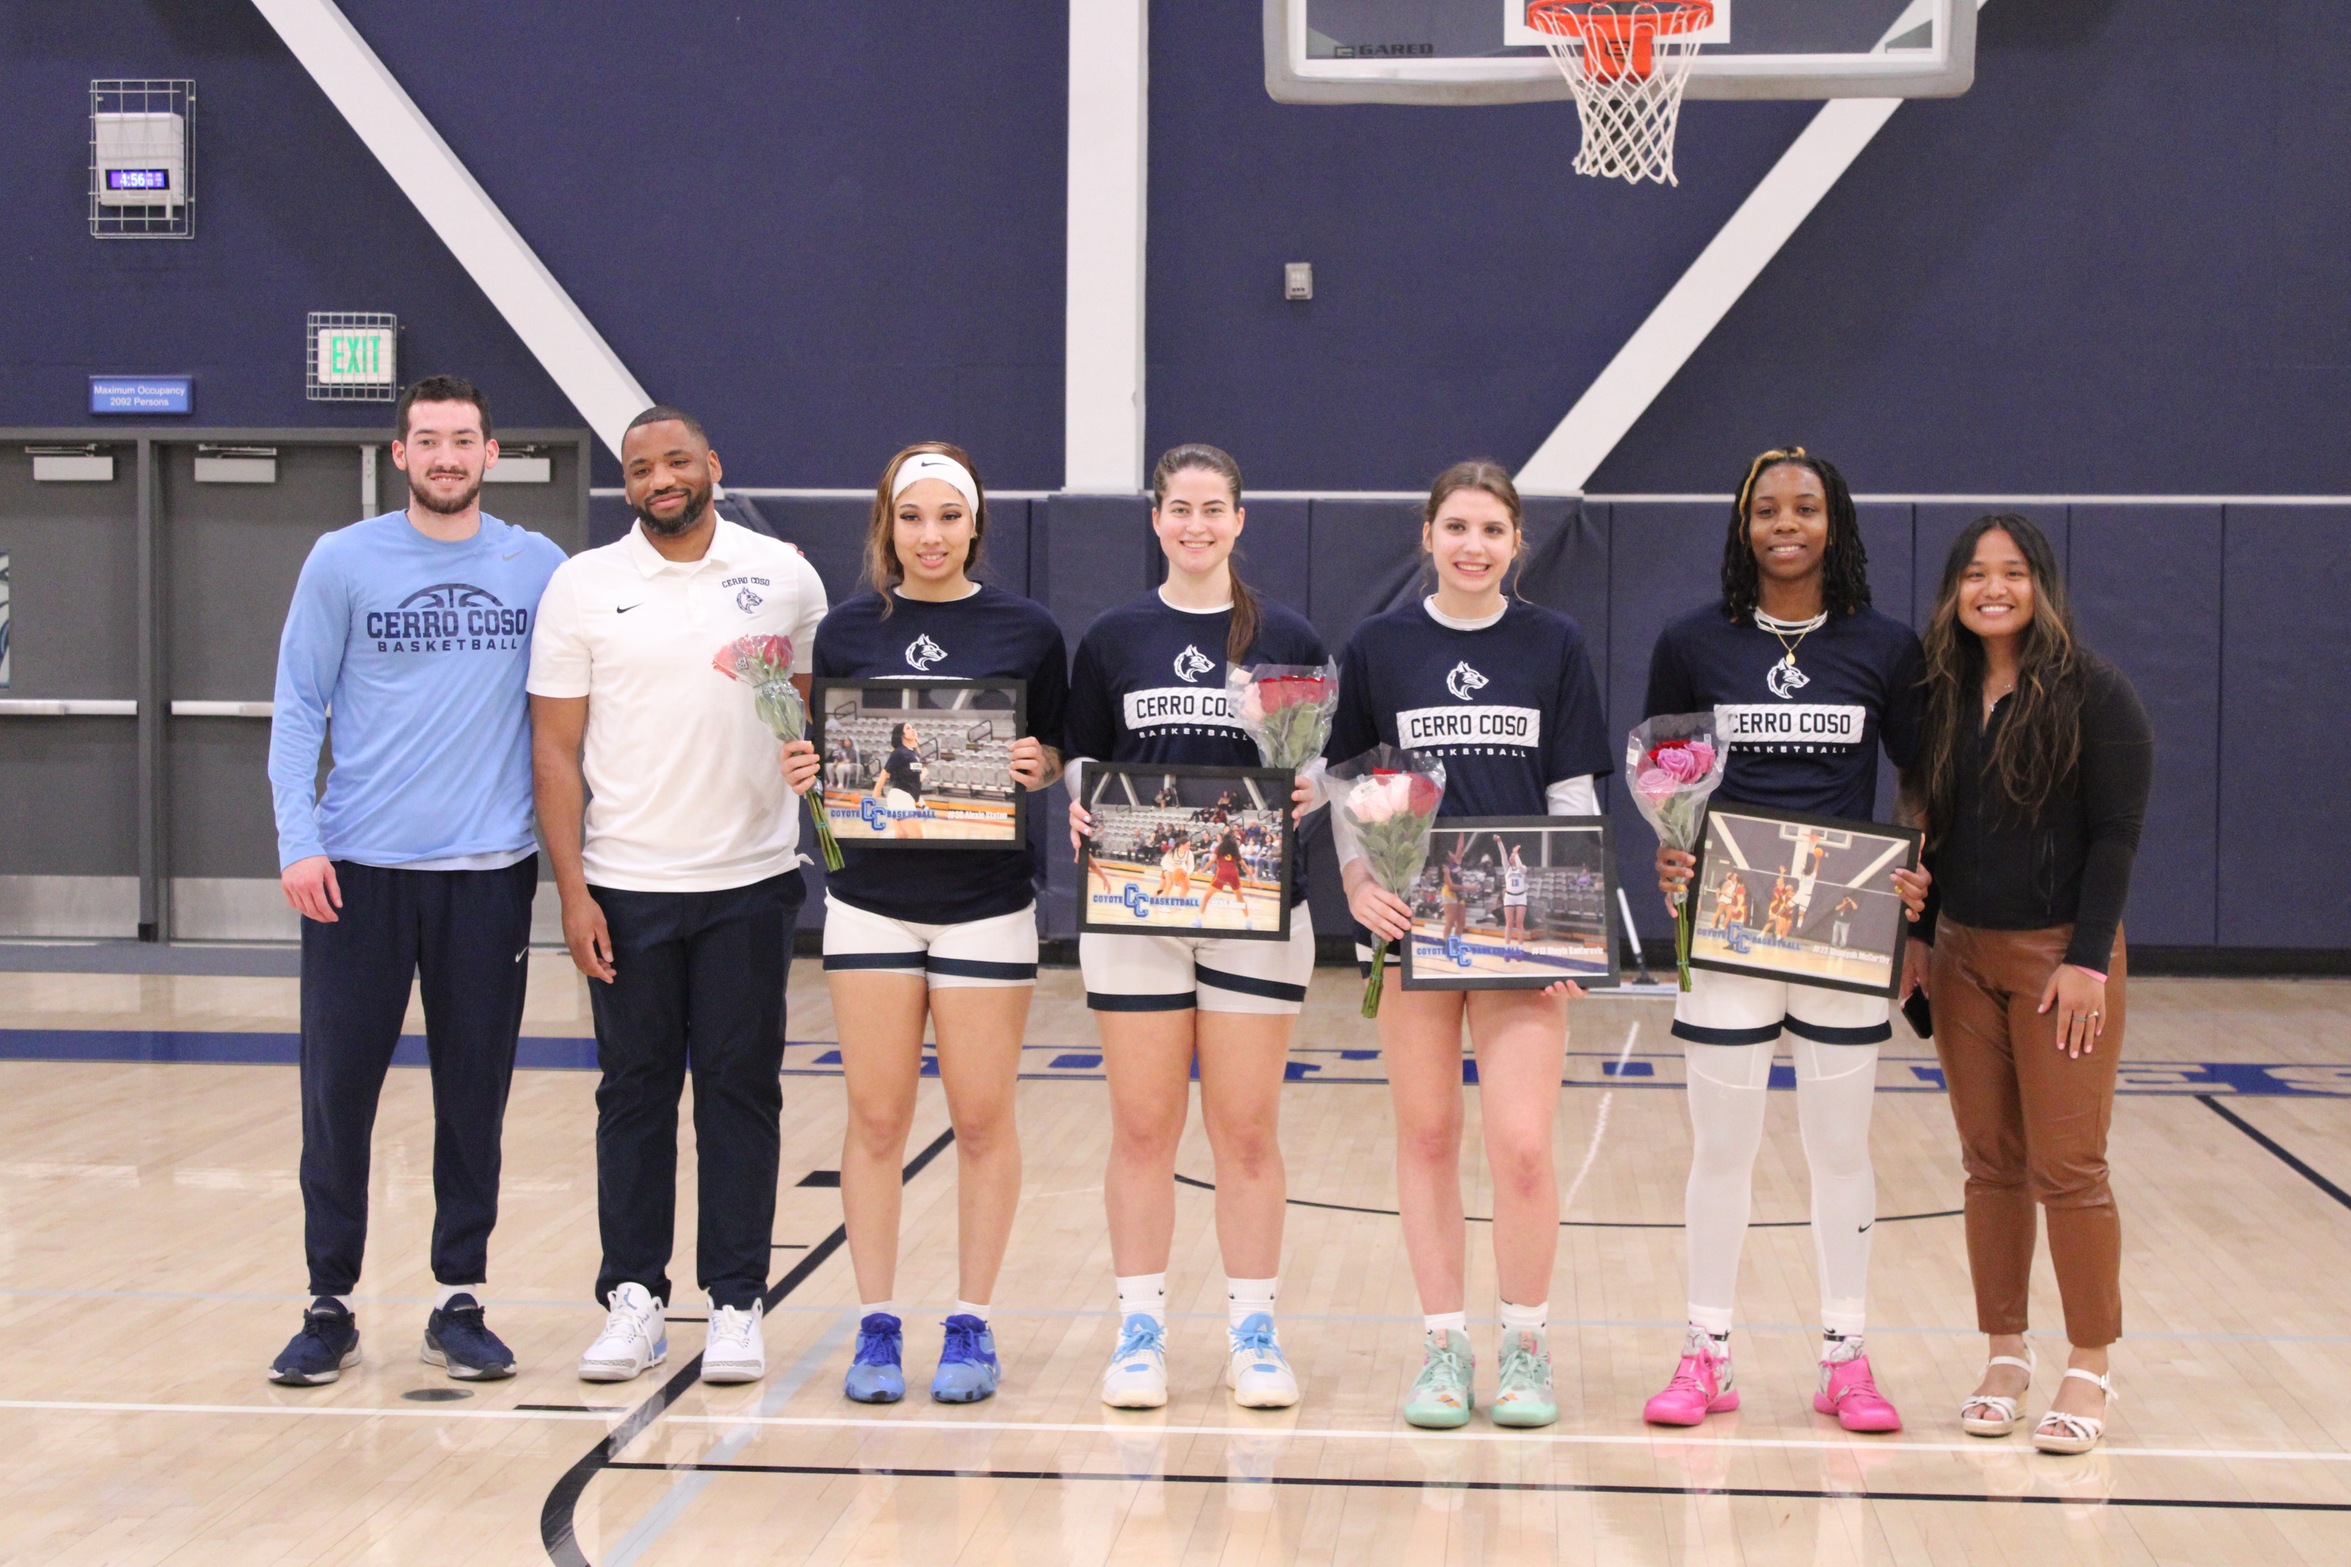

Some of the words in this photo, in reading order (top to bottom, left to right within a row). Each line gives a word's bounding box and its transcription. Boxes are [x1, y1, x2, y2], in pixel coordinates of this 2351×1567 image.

[1359, 43, 1434, 55] GARED
[120, 173, 145, 187] 4:56
[332, 335, 382, 373] EXIT
[94, 386, 136, 395] Maximum
[137, 385, 186, 397] Occupancy
[110, 397, 132, 406] 2092
[133, 397, 170, 406] Persons
[721, 576, 748, 588] CERRO
[750, 577, 770, 586] COSO
[366, 610, 459, 639] CERRO
[467, 608, 528, 636] COSO
[378, 638, 518, 652] BASKETBALL
[1136, 695, 1195, 719] CERRO
[1201, 696, 1236, 719] CO
[1410, 715, 1472, 738] CERRO
[1479, 714, 1528, 737] COSO
[1799, 713, 1851, 735] COSO
[1138, 727, 1248, 741] BASKETBALL
[1412, 747, 1527, 760] BASKETBALL
[1730, 745, 1847, 754] BASKETBALL
[830, 809, 860, 818] COYOTE
[1092, 894, 1124, 904] COYOTE
[1149, 896, 1200, 907] BASKETBALL
[1696, 927, 1727, 940] COYOTE
